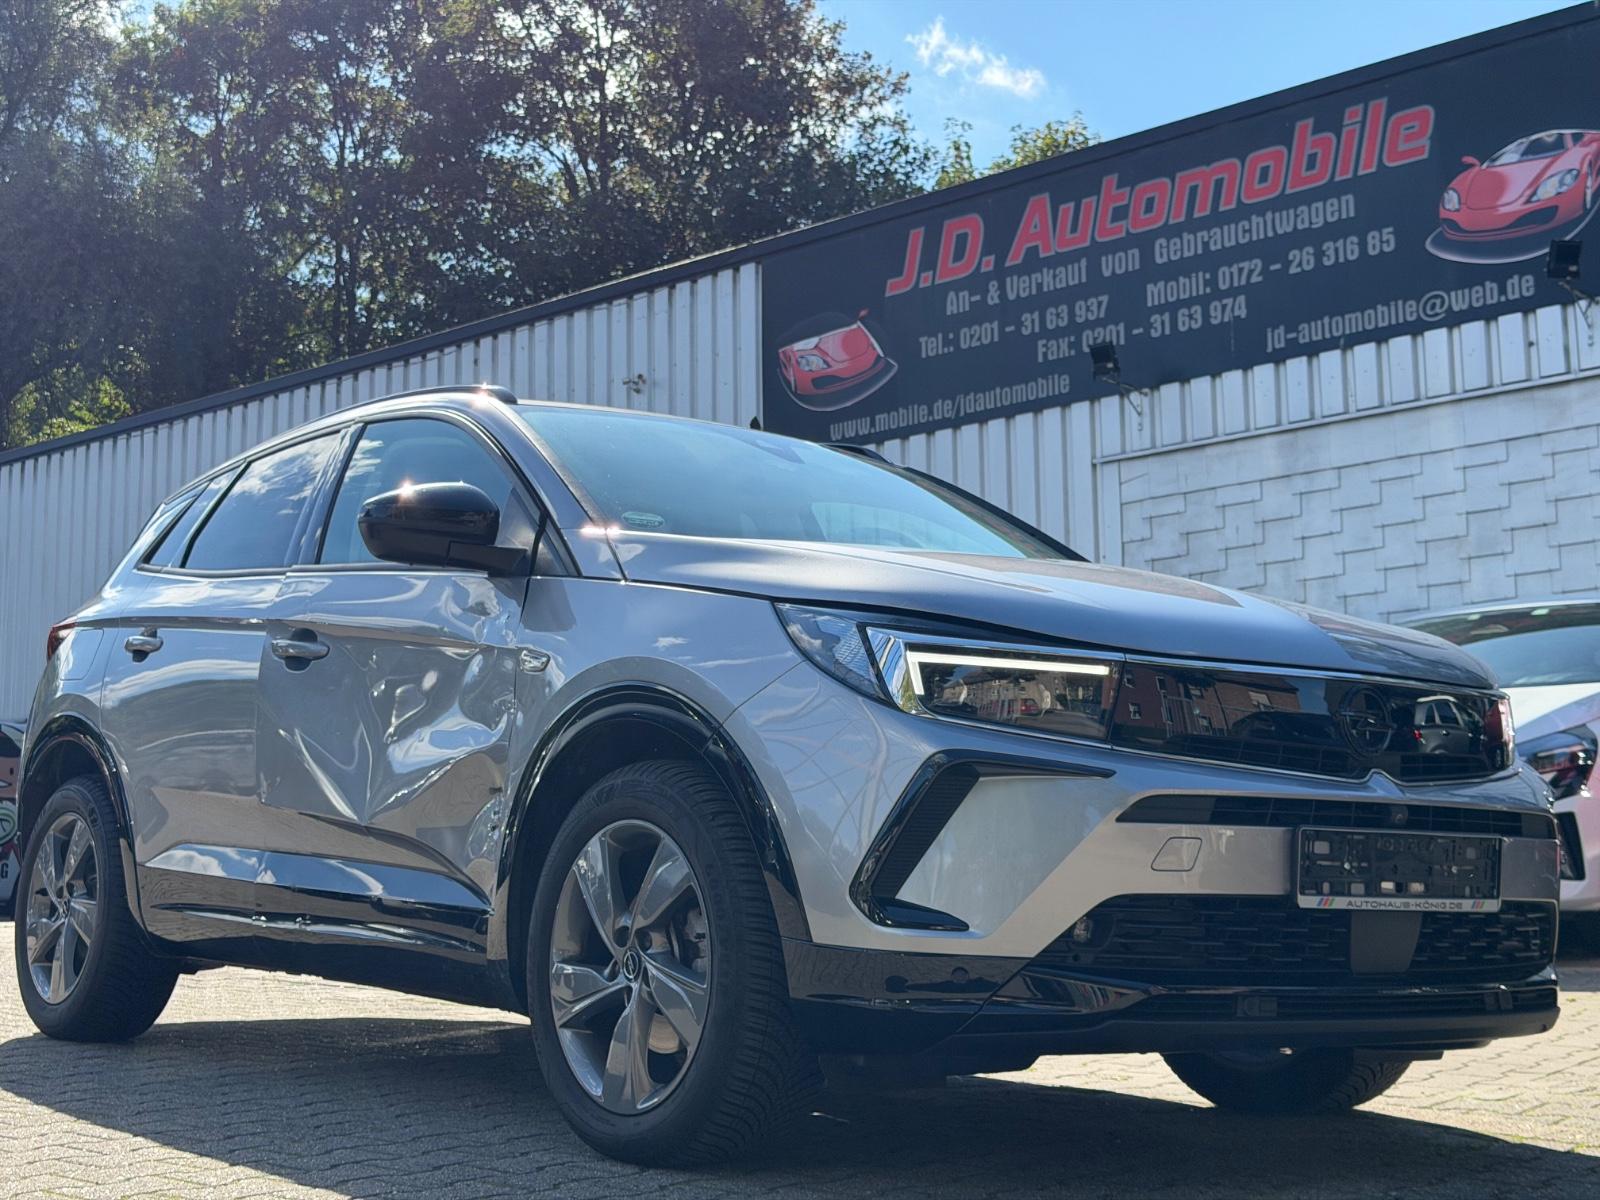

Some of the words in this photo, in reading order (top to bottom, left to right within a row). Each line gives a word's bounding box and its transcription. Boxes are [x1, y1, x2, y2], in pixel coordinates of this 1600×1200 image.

[885, 213, 994, 297] J.D.
[1004, 98, 1436, 267] Automobile
[946, 290, 981, 316] An-
[987, 280, 1001, 306] &
[1005, 257, 1087, 301] Verkauf
[1101, 248, 1141, 278] von
[1154, 194, 1356, 265] Gebrauchtwagen
[1146, 271, 1211, 307] Mobil:
[1217, 258, 1263, 290] 0172
[1288, 246, 1315, 275] 26
[1322, 236, 1359, 267] 316
[1367, 227, 1395, 256] 85
[918, 332, 954, 359] Tel.:
[959, 320, 999, 350] 0201
[1021, 311, 1040, 336] 31
[1046, 304, 1068, 330] 63
[1074, 294, 1109, 324] 937
[1037, 335, 1075, 364] Fax:
[1150, 311, 1171, 338] 31
[1177, 305, 1202, 332] 63
[1209, 294, 1247, 325] 974
[1265, 273, 1535, 353] jd-automobile@web.de
[830, 374, 1070, 441] www.mobile.de/jdautomobile
